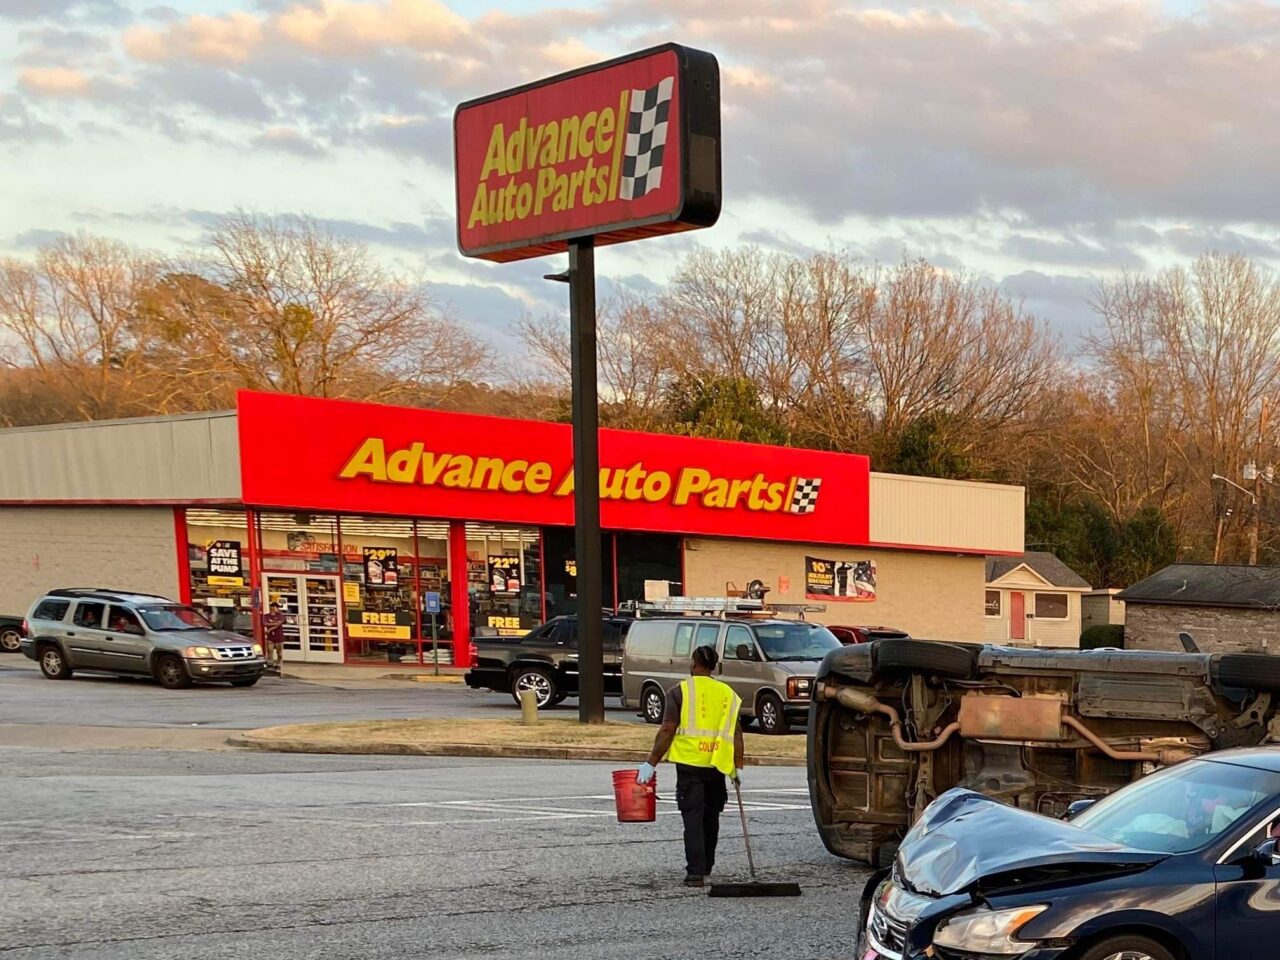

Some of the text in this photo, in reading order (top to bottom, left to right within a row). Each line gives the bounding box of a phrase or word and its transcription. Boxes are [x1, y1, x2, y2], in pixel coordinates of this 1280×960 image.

[480, 107, 615, 181] Advance
[467, 158, 608, 229] Auto Parts
[339, 437, 551, 494] Advance
[674, 468, 786, 513] Parts
[210, 548, 238, 558] SAVE
[210, 564, 239, 573] PUMP
[362, 612, 396, 624] FREE
[488, 616, 520, 628] FREE
